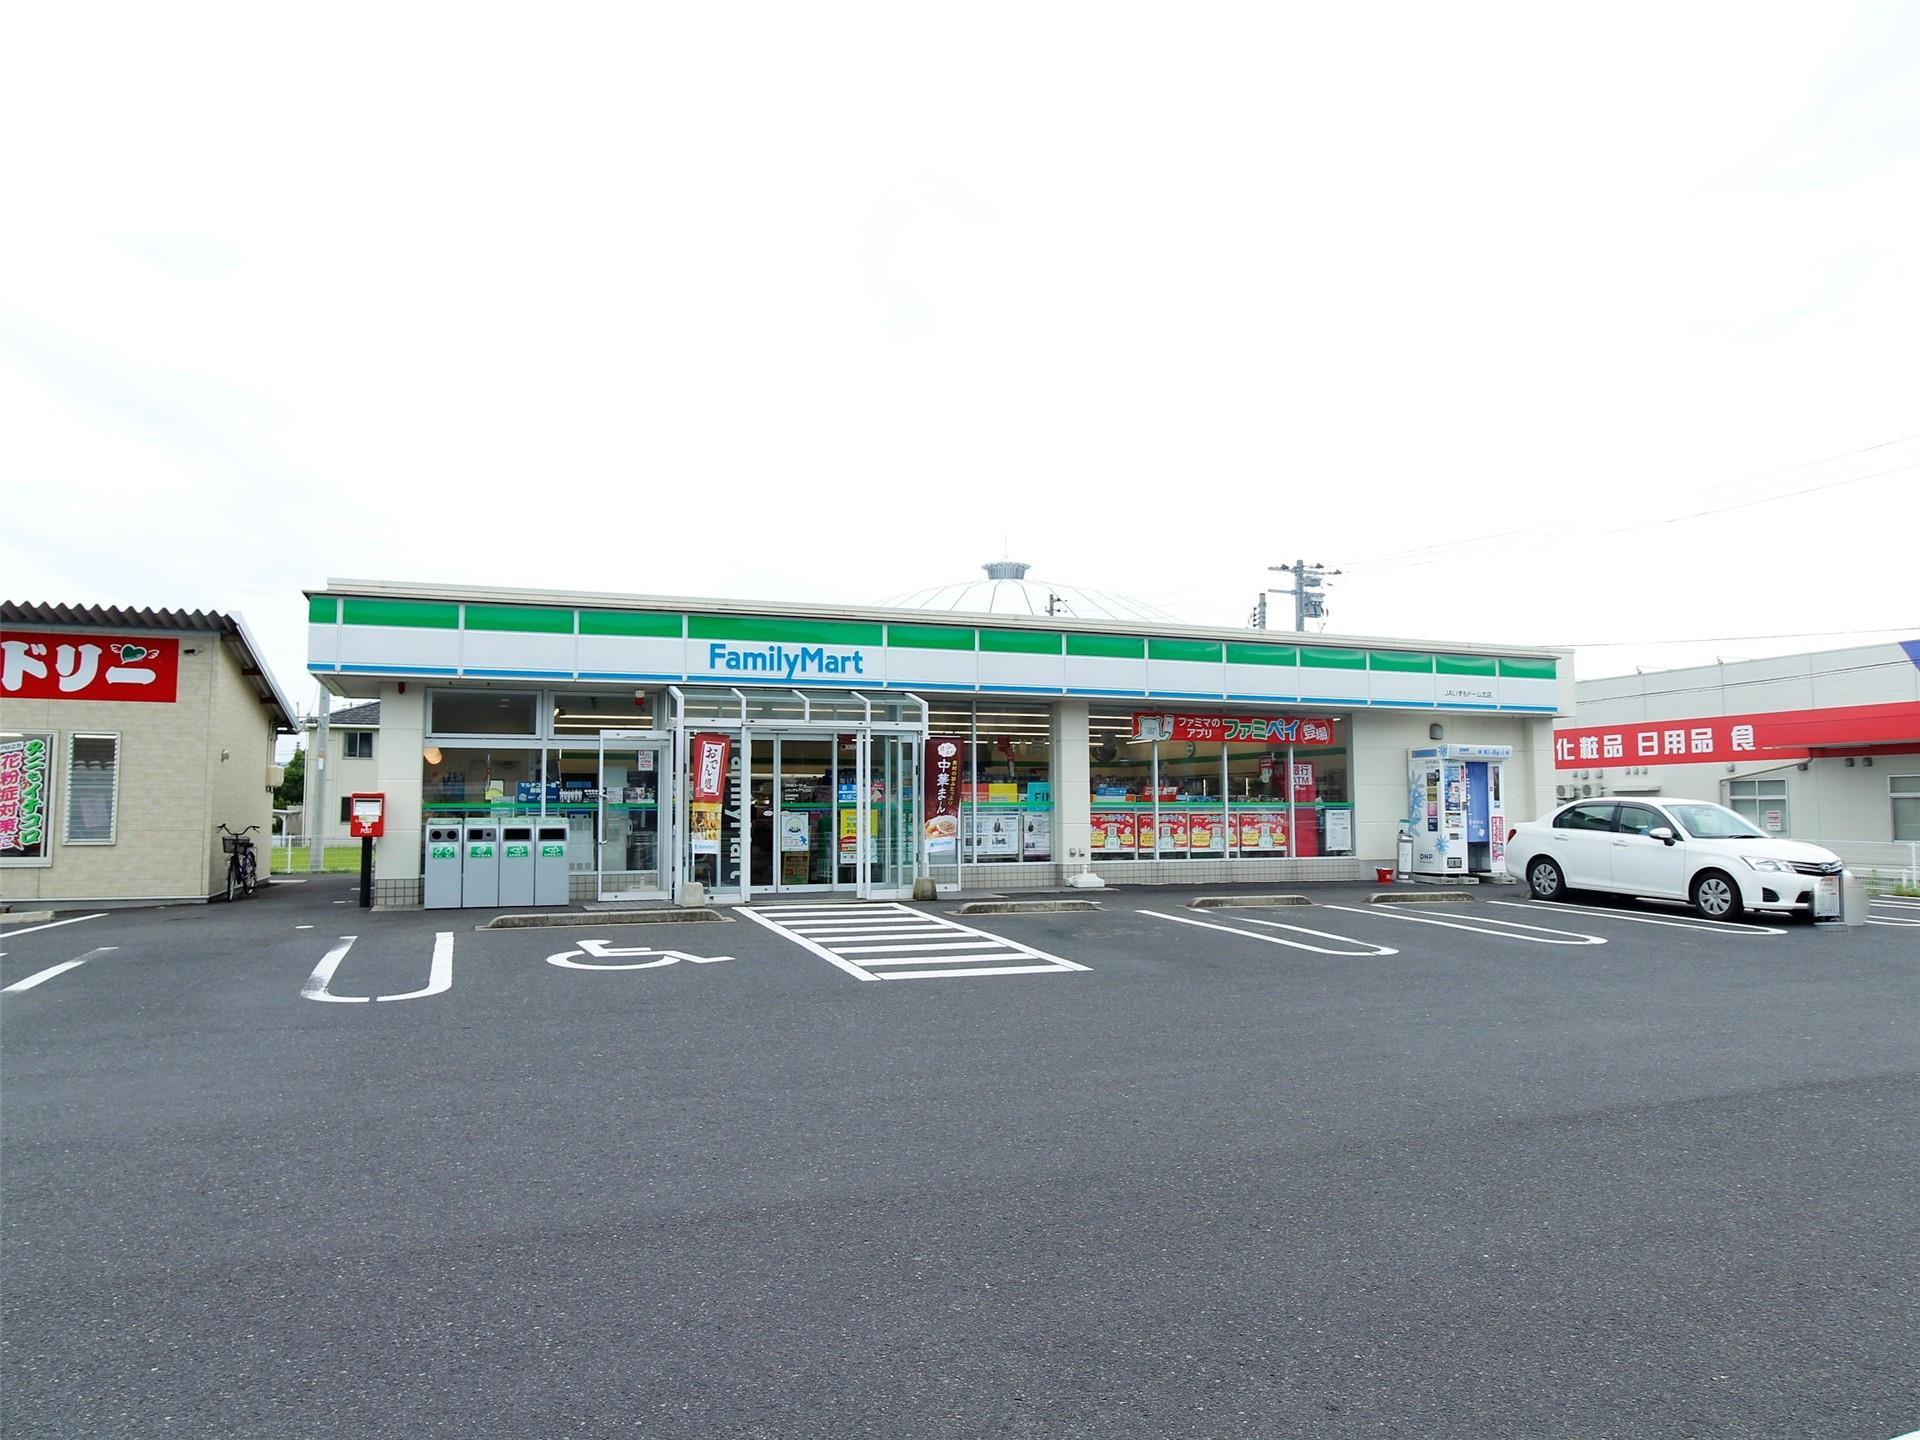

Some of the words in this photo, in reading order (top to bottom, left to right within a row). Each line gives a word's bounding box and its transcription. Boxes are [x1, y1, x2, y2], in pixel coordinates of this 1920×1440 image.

[1, 640, 157, 692] ドリー
[709, 643, 864, 679] FamilyMart
[1178, 717, 1220, 728] ファミマの
[1187, 729, 1213, 739] アプリ
[1222, 718, 1299, 741] ファミペイ
[1303, 724, 1329, 741] 登場
[1556, 734, 1624, 760] 化粧品
[1637, 727, 1713, 756] 日用品
[937, 759, 951, 814] 中華まん
